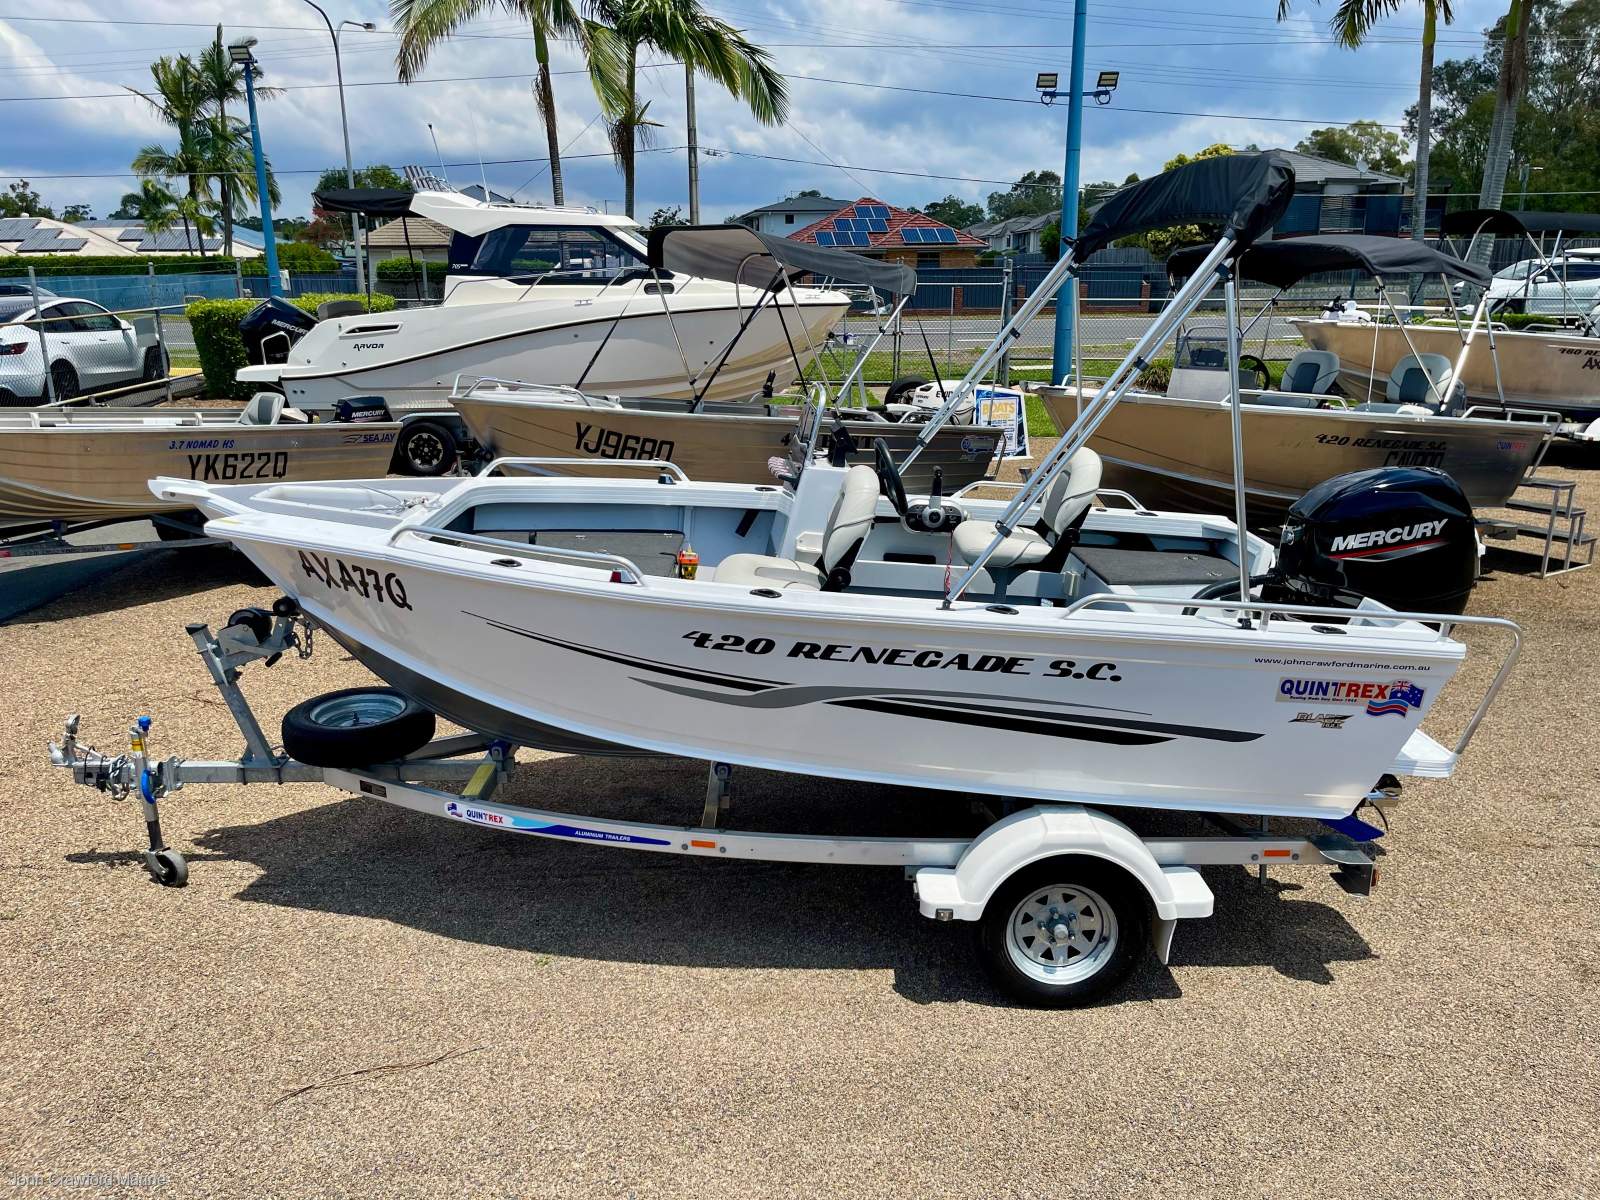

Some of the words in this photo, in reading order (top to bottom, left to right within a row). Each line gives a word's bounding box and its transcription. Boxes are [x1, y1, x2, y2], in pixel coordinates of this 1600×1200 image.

[353, 343, 385, 351] ARVOR
[352, 409, 385, 418] MERCURY
[363, 433, 379, 442] SEA
[381, 432, 396, 442] JAY
[1314, 433, 1351, 446] 420
[1352, 438, 1425, 450] RENEGADE
[169, 441, 184, 450] 3.7
[186, 440, 220, 449] NOMAD
[222, 440, 235, 448] HS
[187, 451, 289, 480] YK622Q
[1330, 518, 1449, 552] MERCURY
[298, 550, 413, 611] AXA77Q
[682, 630, 776, 655] 420
[786, 641, 1036, 675] RENEGADE
[1042, 660, 1123, 682] S.C.
[1254, 657, 1431, 672] www.johncrawfordmarine.com.au
[1280, 679, 1390, 700] QUINTREX
[466, 809, 504, 824] QUINTREX
[604, 833, 631, 842] TRAILERS
